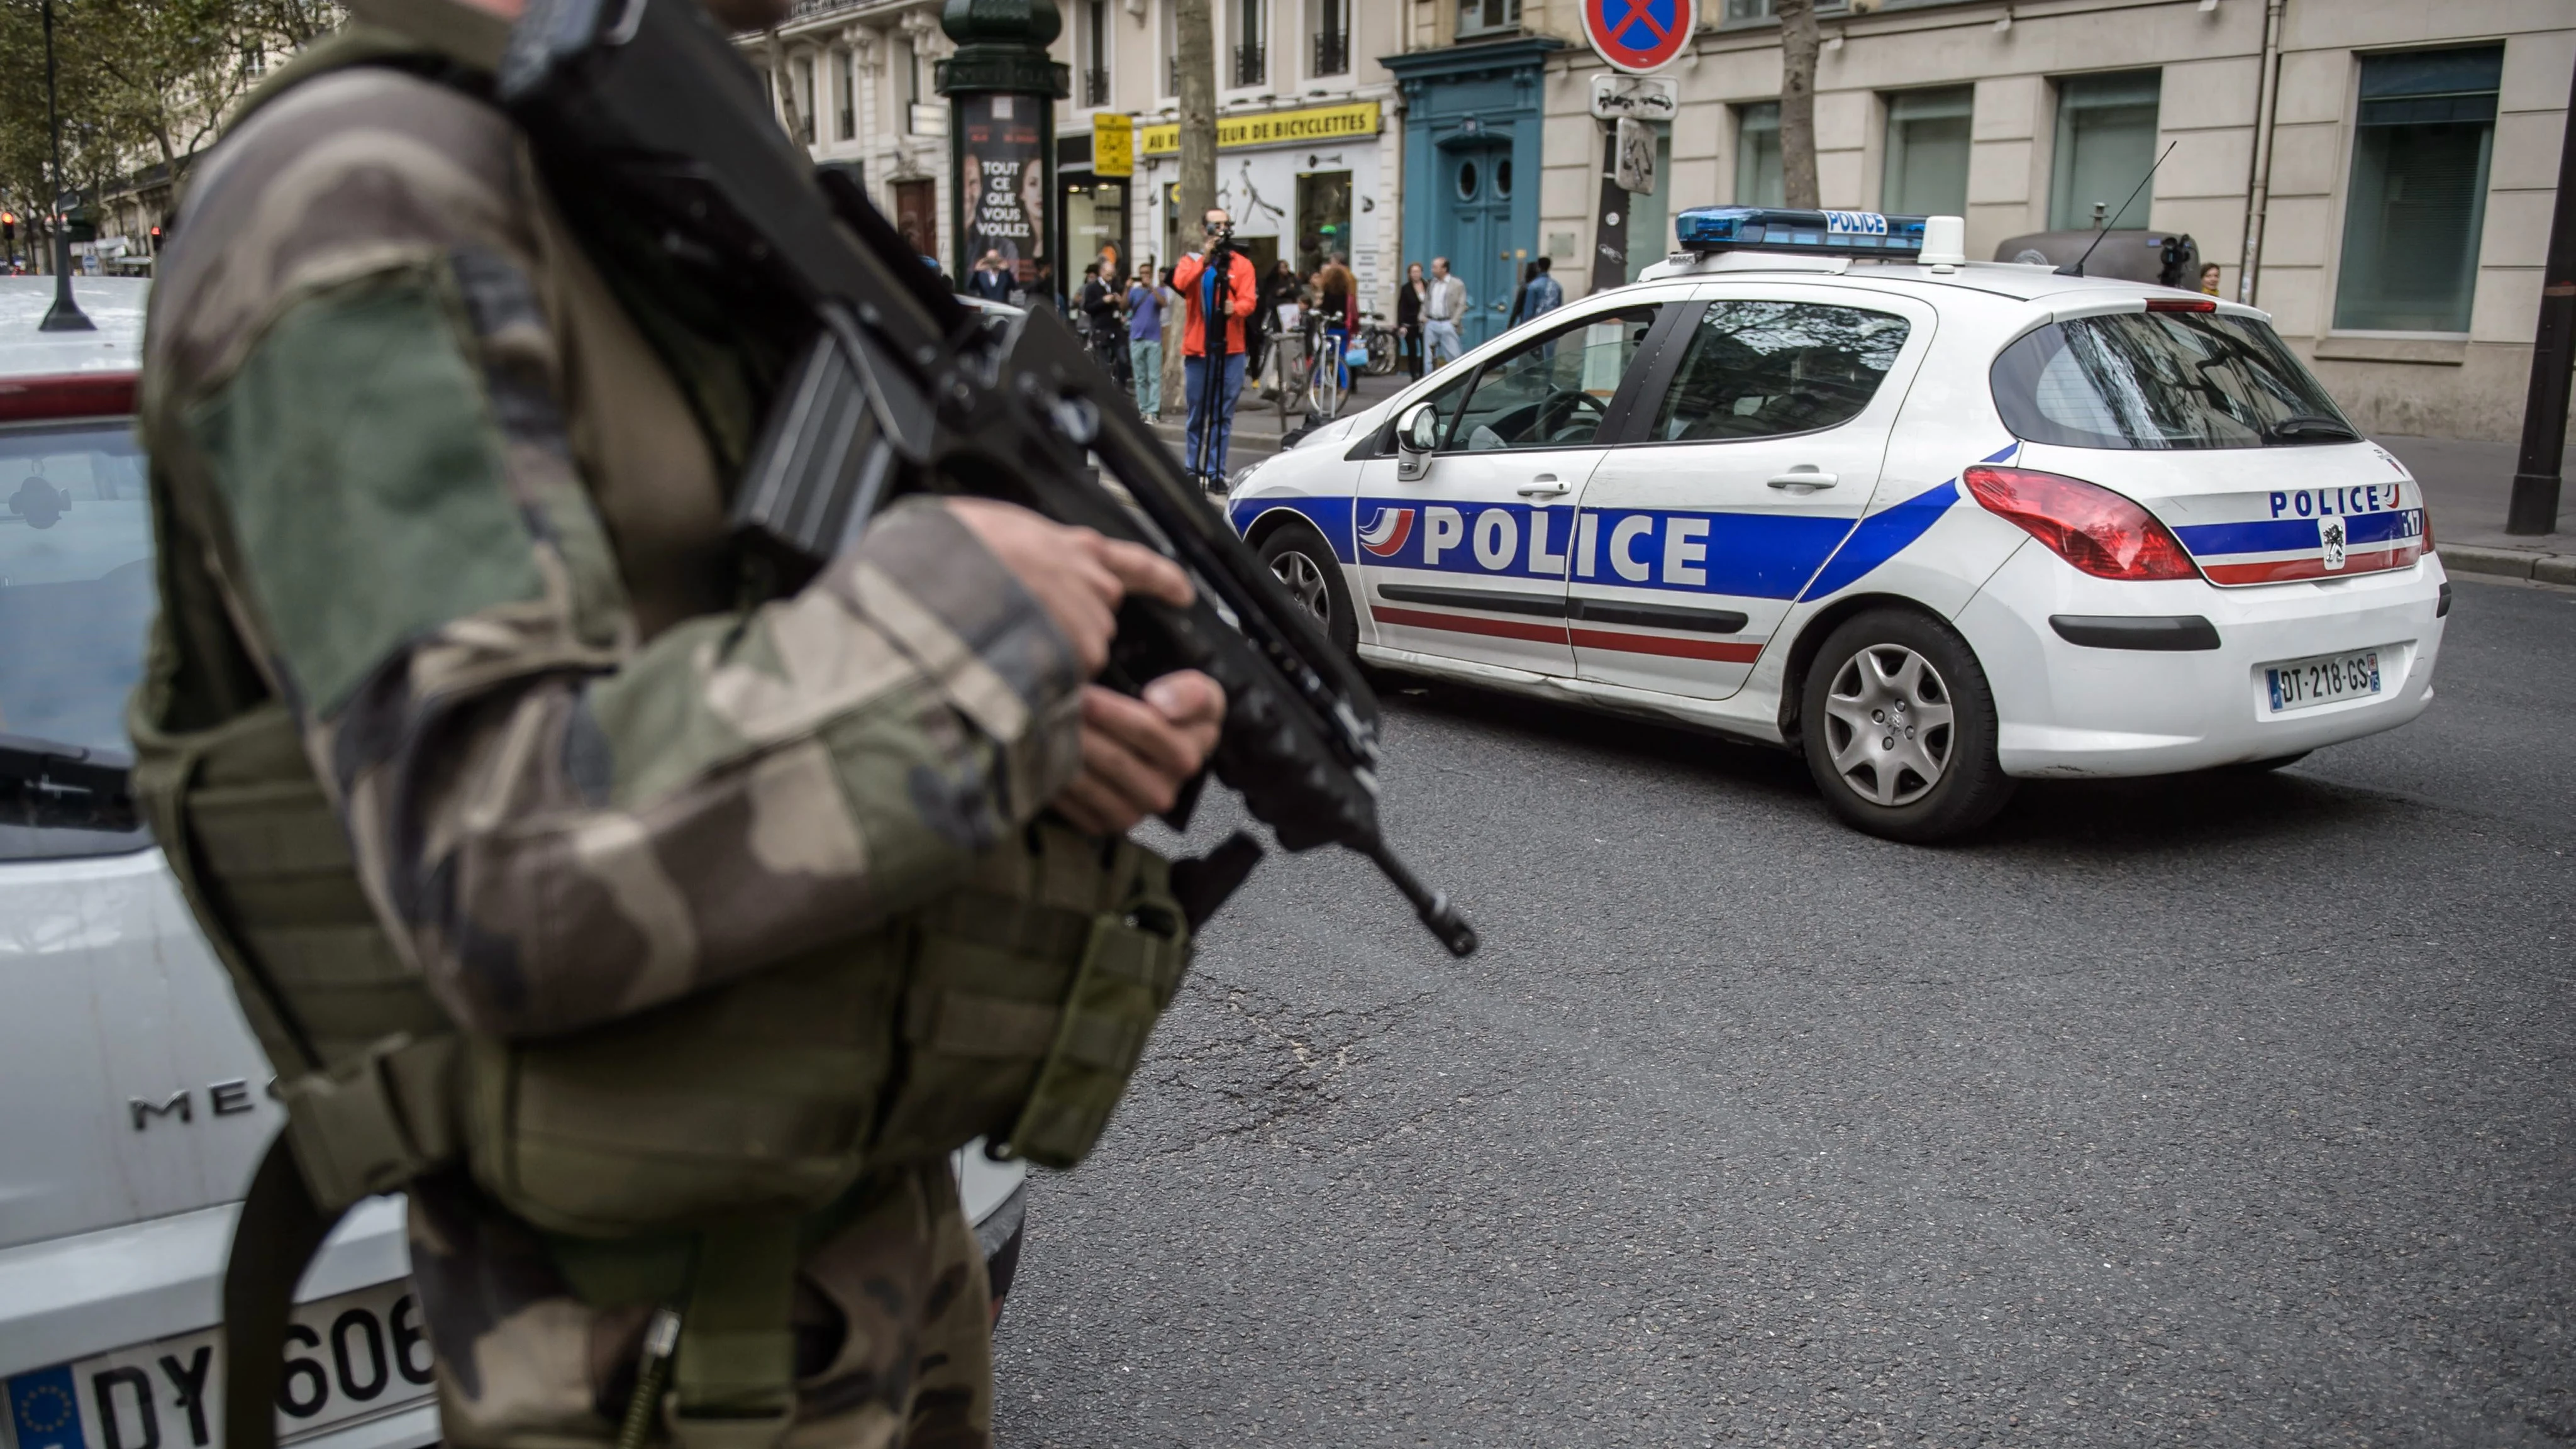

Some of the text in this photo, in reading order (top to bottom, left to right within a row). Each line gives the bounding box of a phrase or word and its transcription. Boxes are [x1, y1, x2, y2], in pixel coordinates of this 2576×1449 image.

[1148, 133, 1165, 148] AU
[1252, 123, 1269, 140] DE
[1274, 113, 1366, 137] BICYCLETTES
[982, 161, 1020, 175] TOUT
[991, 177, 1011, 191] CE
[985, 192, 1016, 206] QUE
[981, 207, 1021, 222] VOUS
[1825, 211, 1884, 233] POLICE
[976, 221, 1030, 237] VOULEZ
[2269, 486, 2380, 519] POLICE
[1424, 506, 1710, 586] POLICE
[128, 1074, 286, 1132] ME
